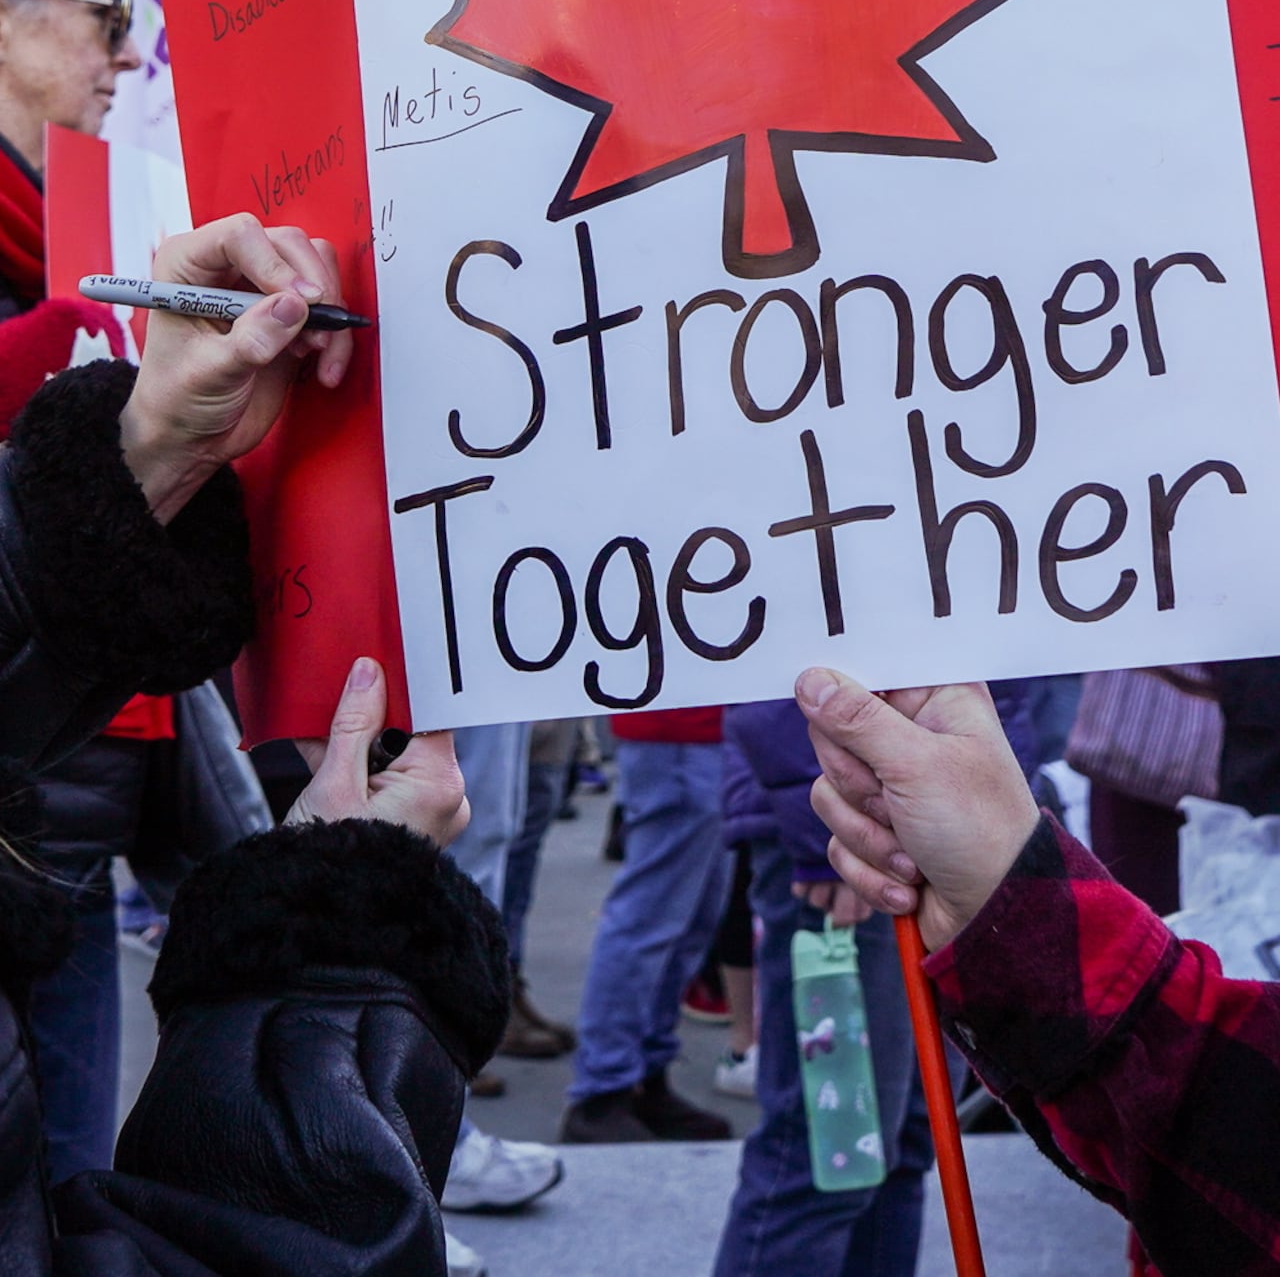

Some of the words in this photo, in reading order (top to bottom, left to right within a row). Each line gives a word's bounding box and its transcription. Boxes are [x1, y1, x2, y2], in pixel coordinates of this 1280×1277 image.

[250, 125, 346, 216] Veterans
[383, 68, 482, 149] Metis
[445, 220, 1227, 479] Stronger
[393, 410, 1247, 710] Together
